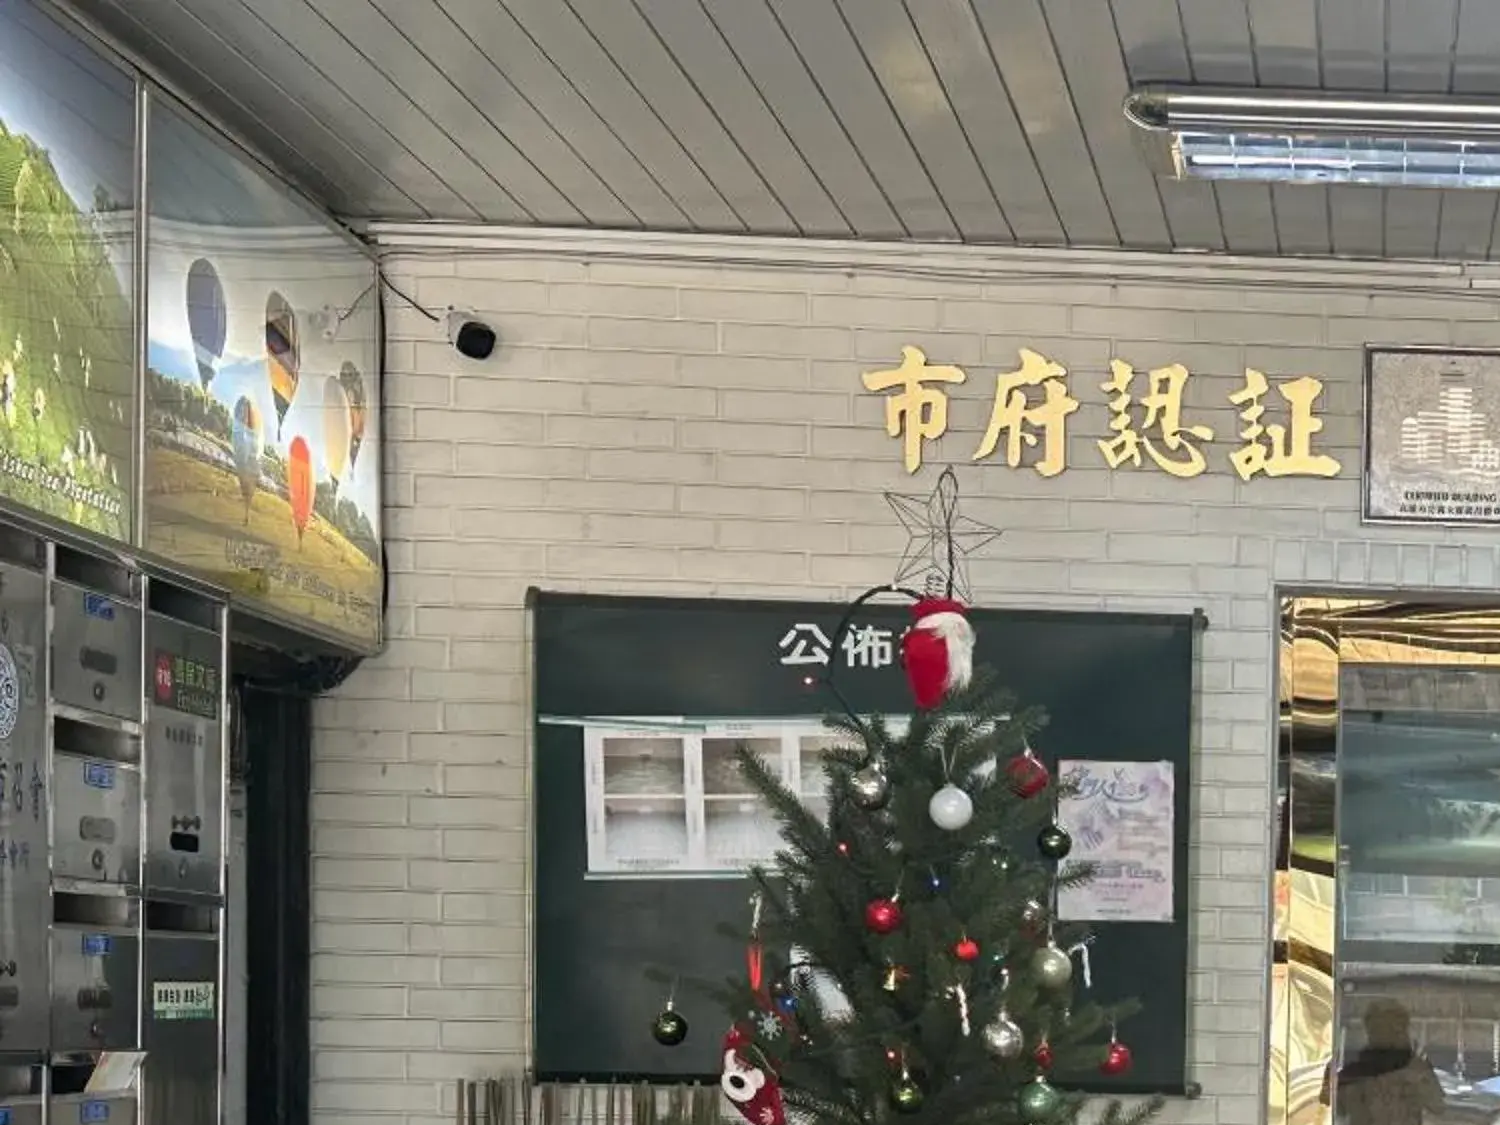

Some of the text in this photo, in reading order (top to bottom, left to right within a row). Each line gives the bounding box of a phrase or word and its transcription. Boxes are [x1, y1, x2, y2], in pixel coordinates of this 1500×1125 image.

[861, 345, 1343, 482] 市府認証
[778, 622, 911, 669] 公佈
